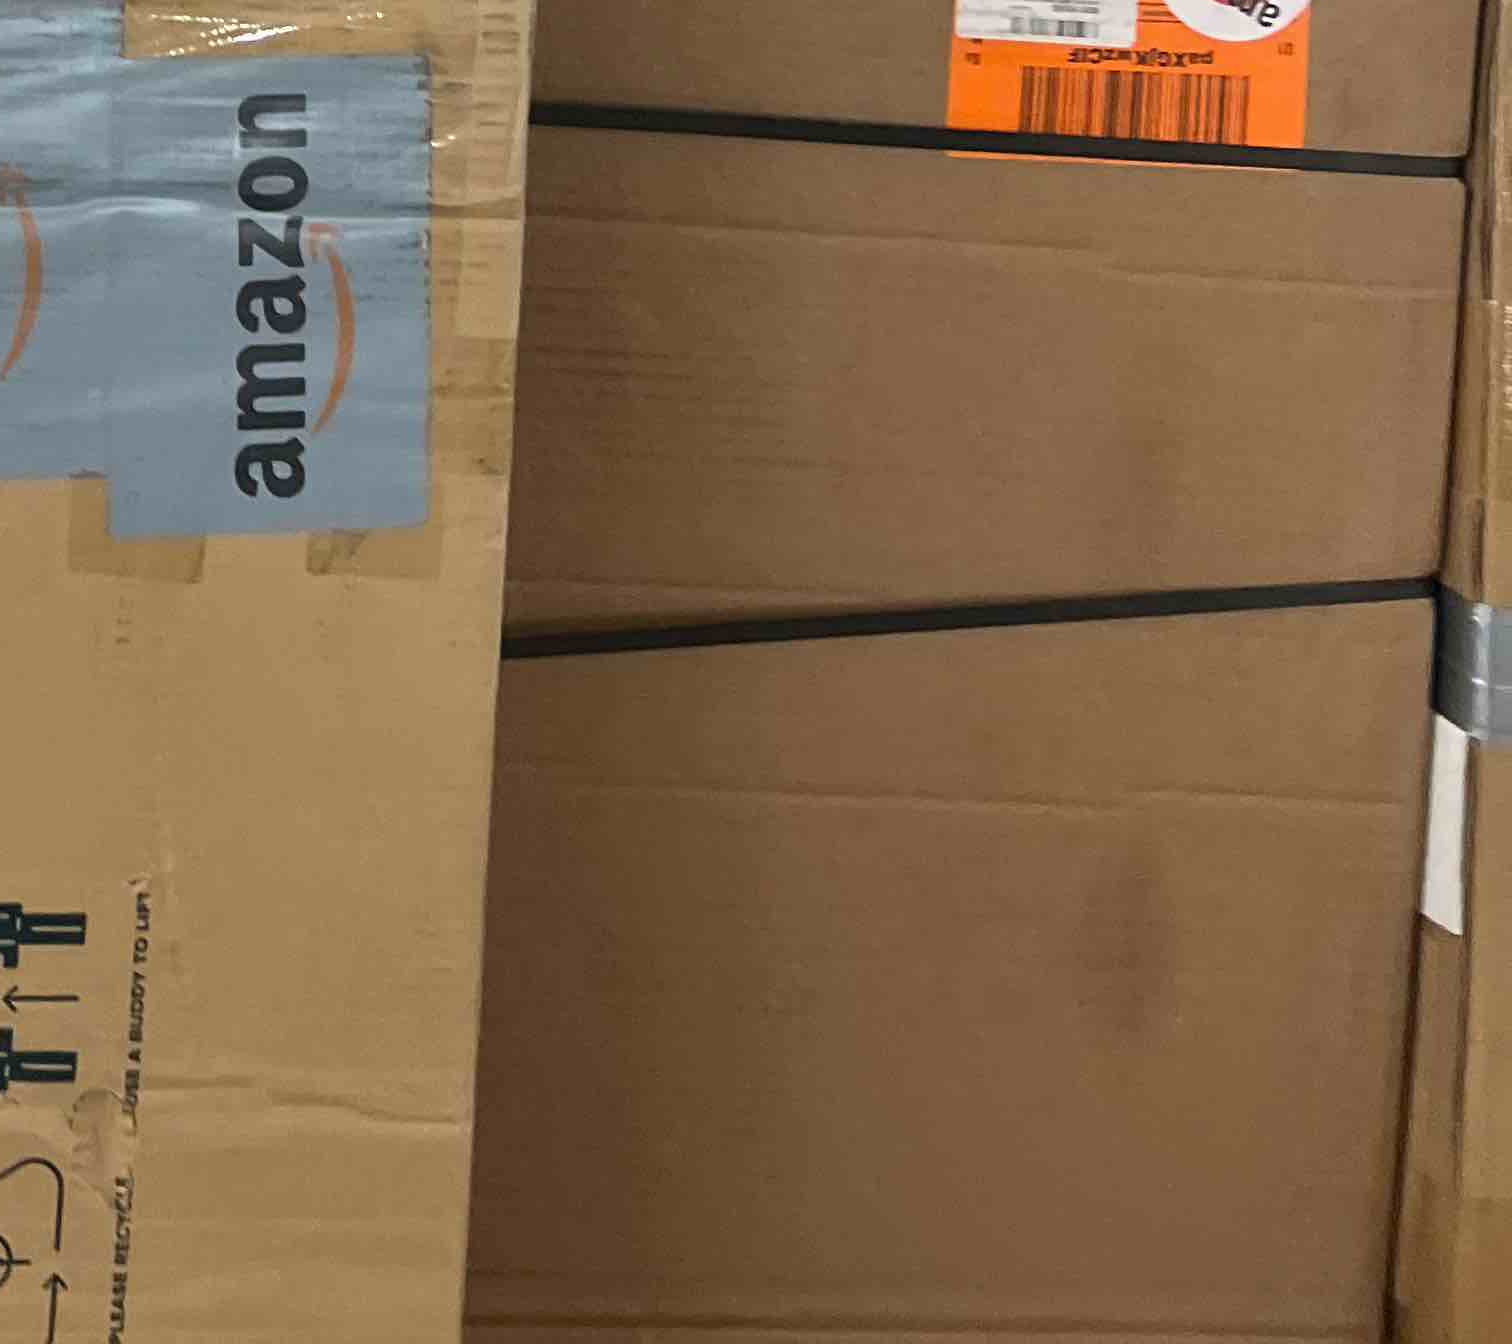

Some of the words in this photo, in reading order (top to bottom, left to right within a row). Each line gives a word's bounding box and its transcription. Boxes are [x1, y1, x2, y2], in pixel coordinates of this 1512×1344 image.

[234, 92, 309, 499] amazon
[133, 937, 149, 964] TO
[129, 970, 145, 1043] BUDDY
[128, 1047, 142, 1064] A
[108, 1271, 128, 1344] PLEASE
